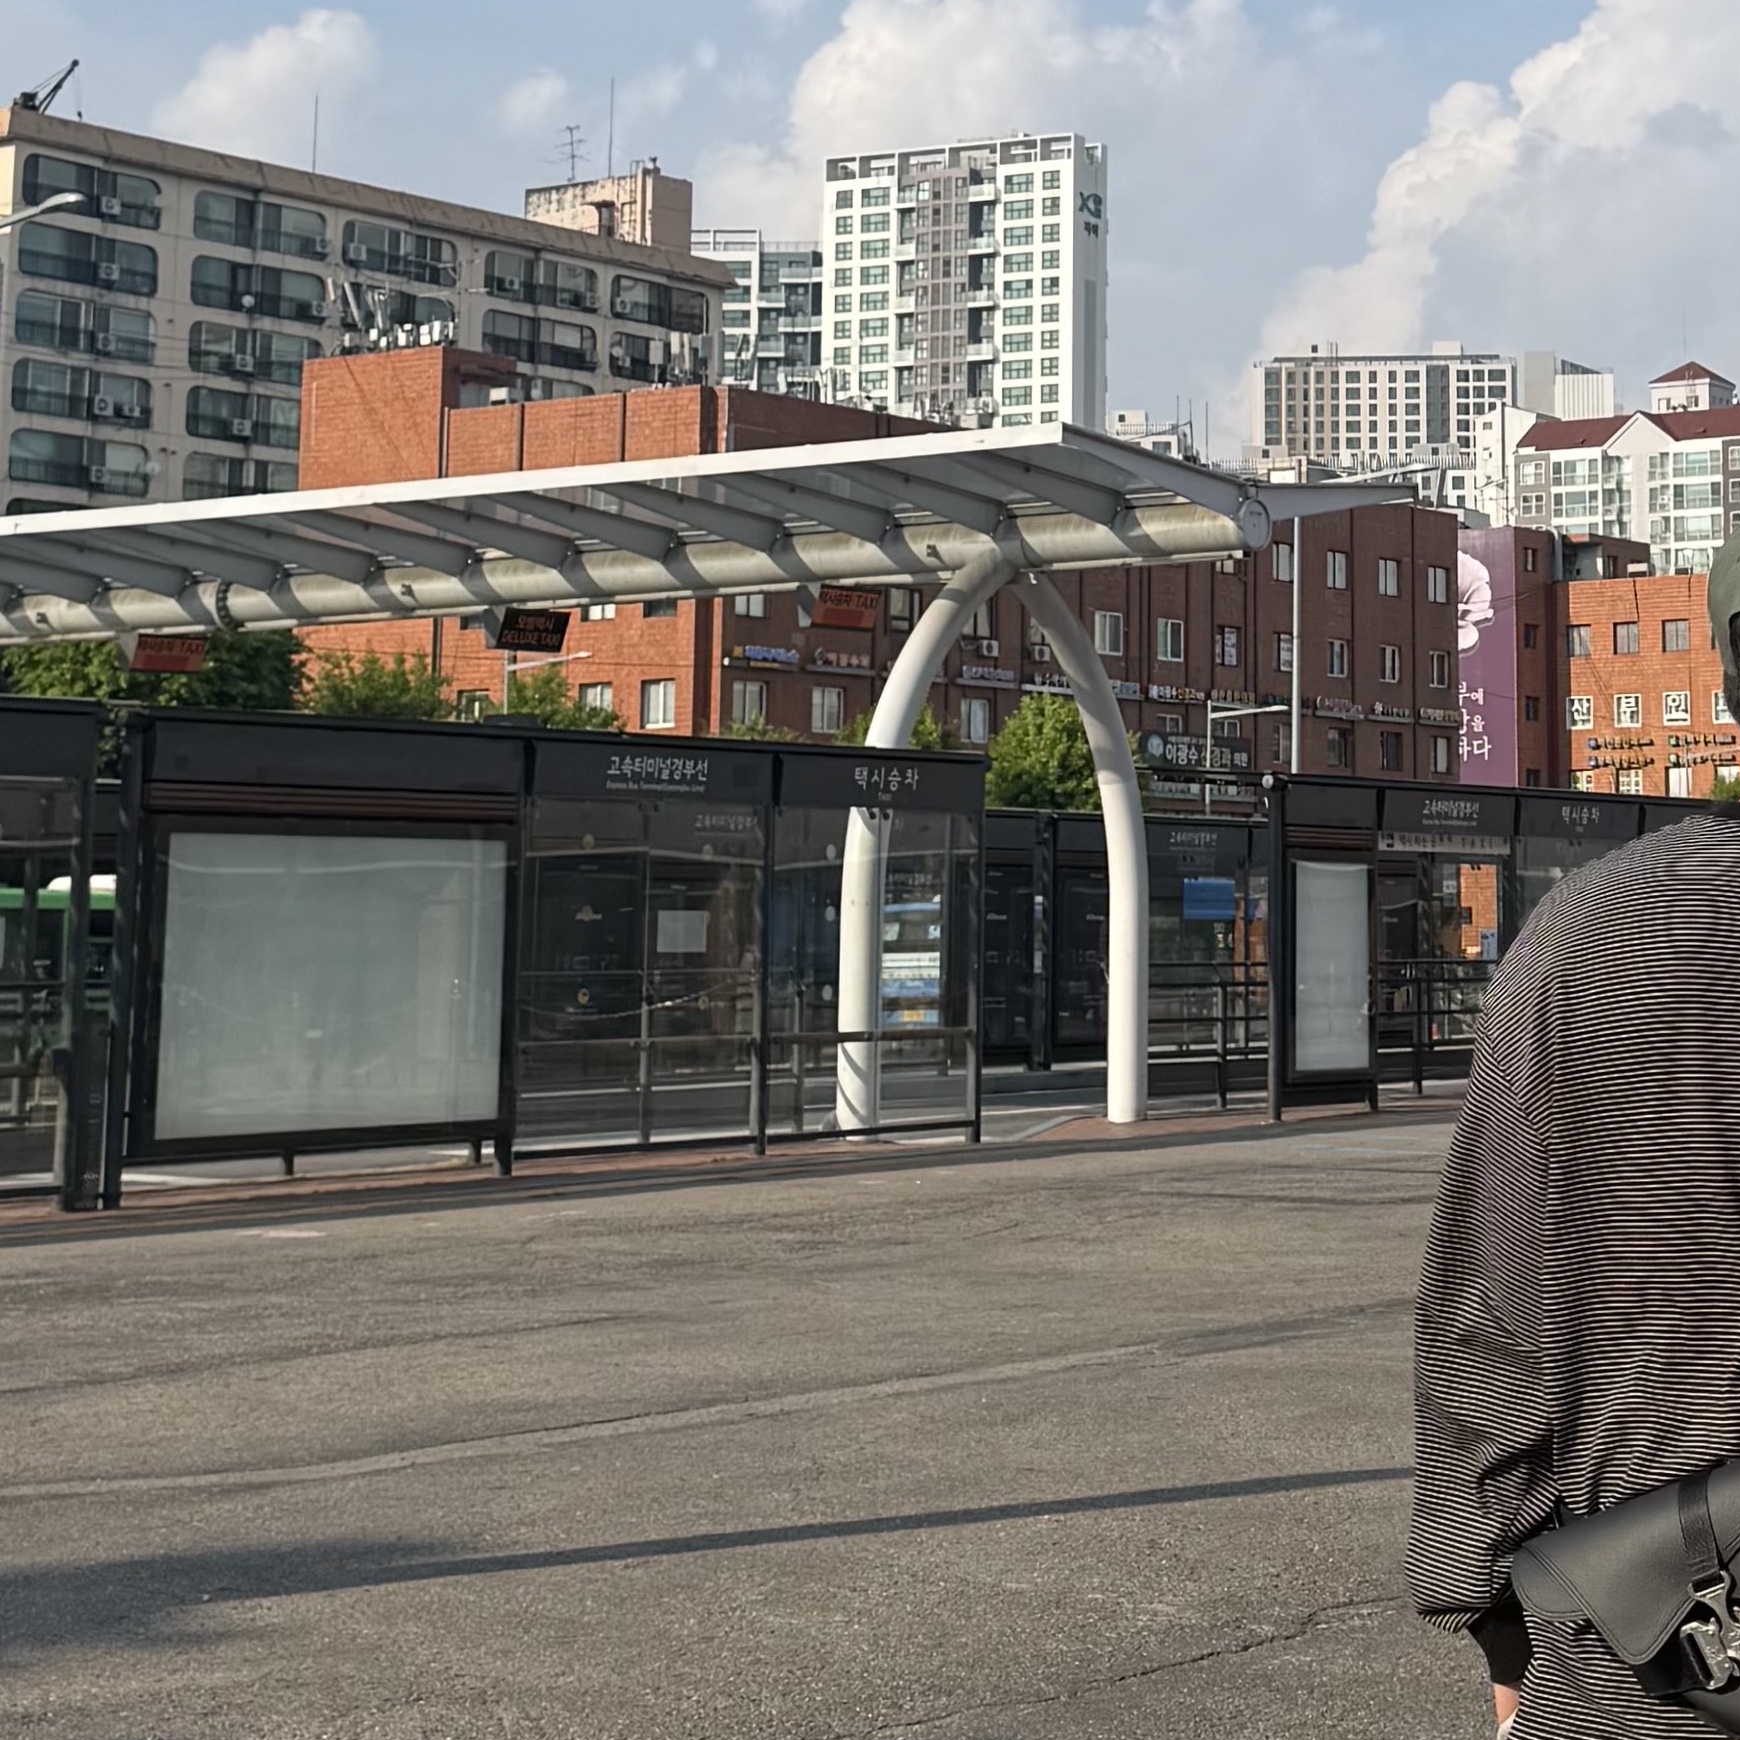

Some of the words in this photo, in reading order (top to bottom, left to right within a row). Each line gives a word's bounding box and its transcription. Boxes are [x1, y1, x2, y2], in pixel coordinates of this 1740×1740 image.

[1165, 743, 1199, 765] 이광수
[607, 755, 709, 781] 고속터미널경부선
[854, 766, 919, 791] 택시승차
